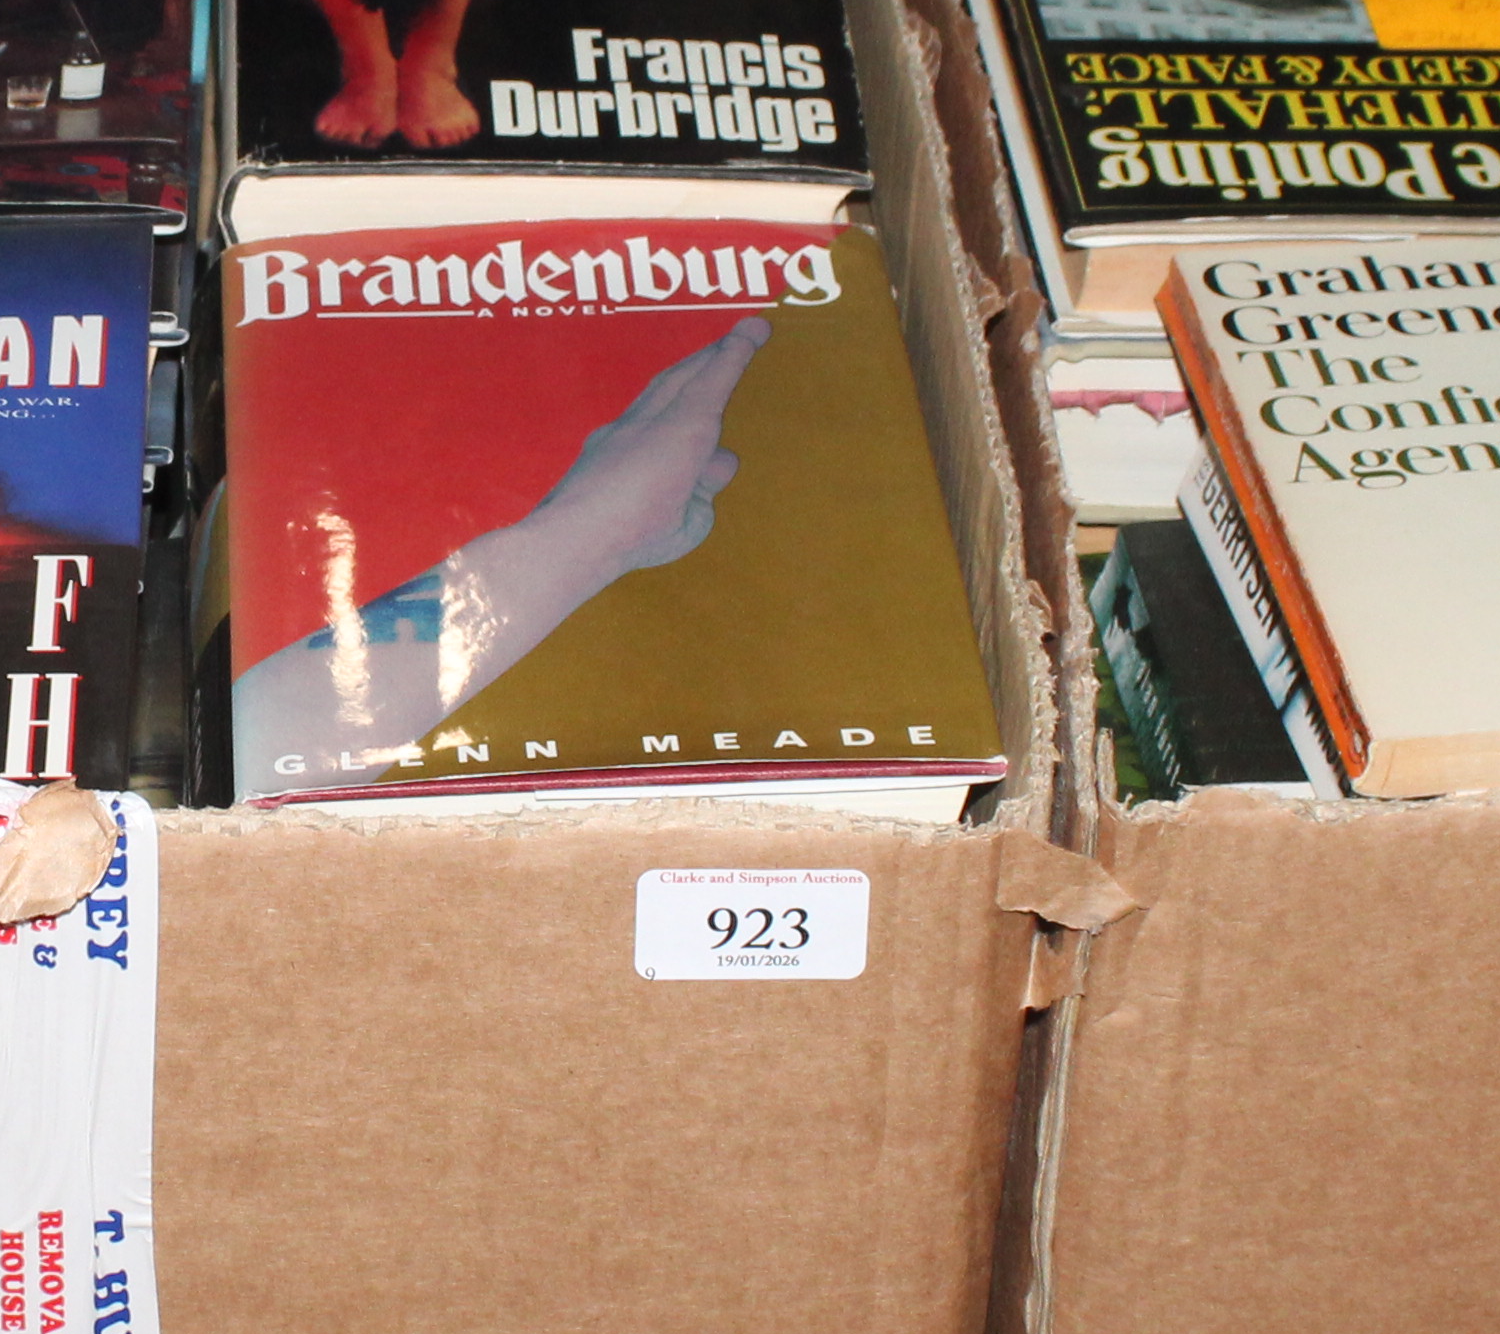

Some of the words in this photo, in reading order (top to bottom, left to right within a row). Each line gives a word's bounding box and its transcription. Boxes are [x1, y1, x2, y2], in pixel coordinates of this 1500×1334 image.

[572, 28, 825, 90] Francis
[1067, 51, 1271, 84] FARCE
[1276, 53, 1322, 83] &
[490, 79, 838, 152] Durbridge
[1088, 126, 1455, 202] Ponting
[236, 235, 843, 329] Brandenburg
[511, 304, 616, 318] NOVEL
[1236, 349, 1423, 393] The
[273, 740, 560, 775] GLENN
[642, 726, 938, 754] MEADE
[660, 872, 705, 884] Clarke
[709, 872, 734, 884] and
[739, 872, 797, 887] Simpson
[802, 872, 863, 884] Auctions
[707, 907, 810, 950] 923
[717, 955, 800, 967] 19/01/2026
